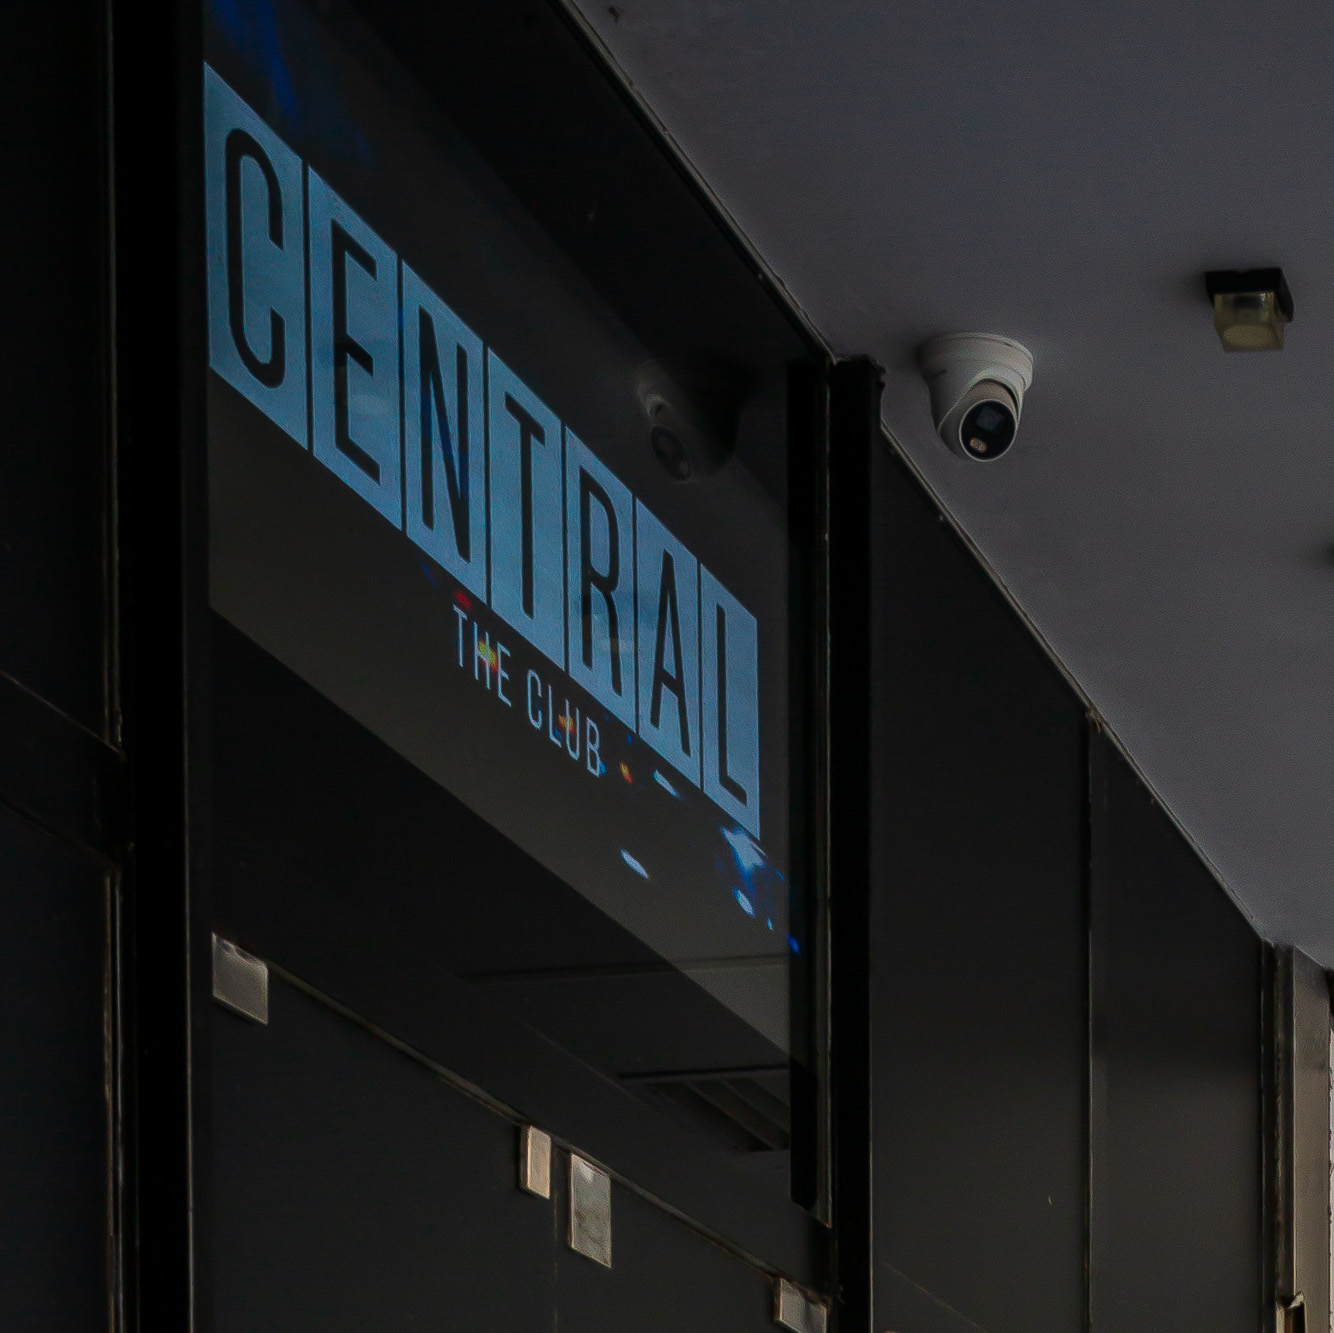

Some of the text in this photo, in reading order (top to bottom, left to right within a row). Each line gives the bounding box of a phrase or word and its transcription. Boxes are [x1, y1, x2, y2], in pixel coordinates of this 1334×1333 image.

[221, 126, 752, 818] CENTRAL
[453, 602, 604, 777] THE CLUB
